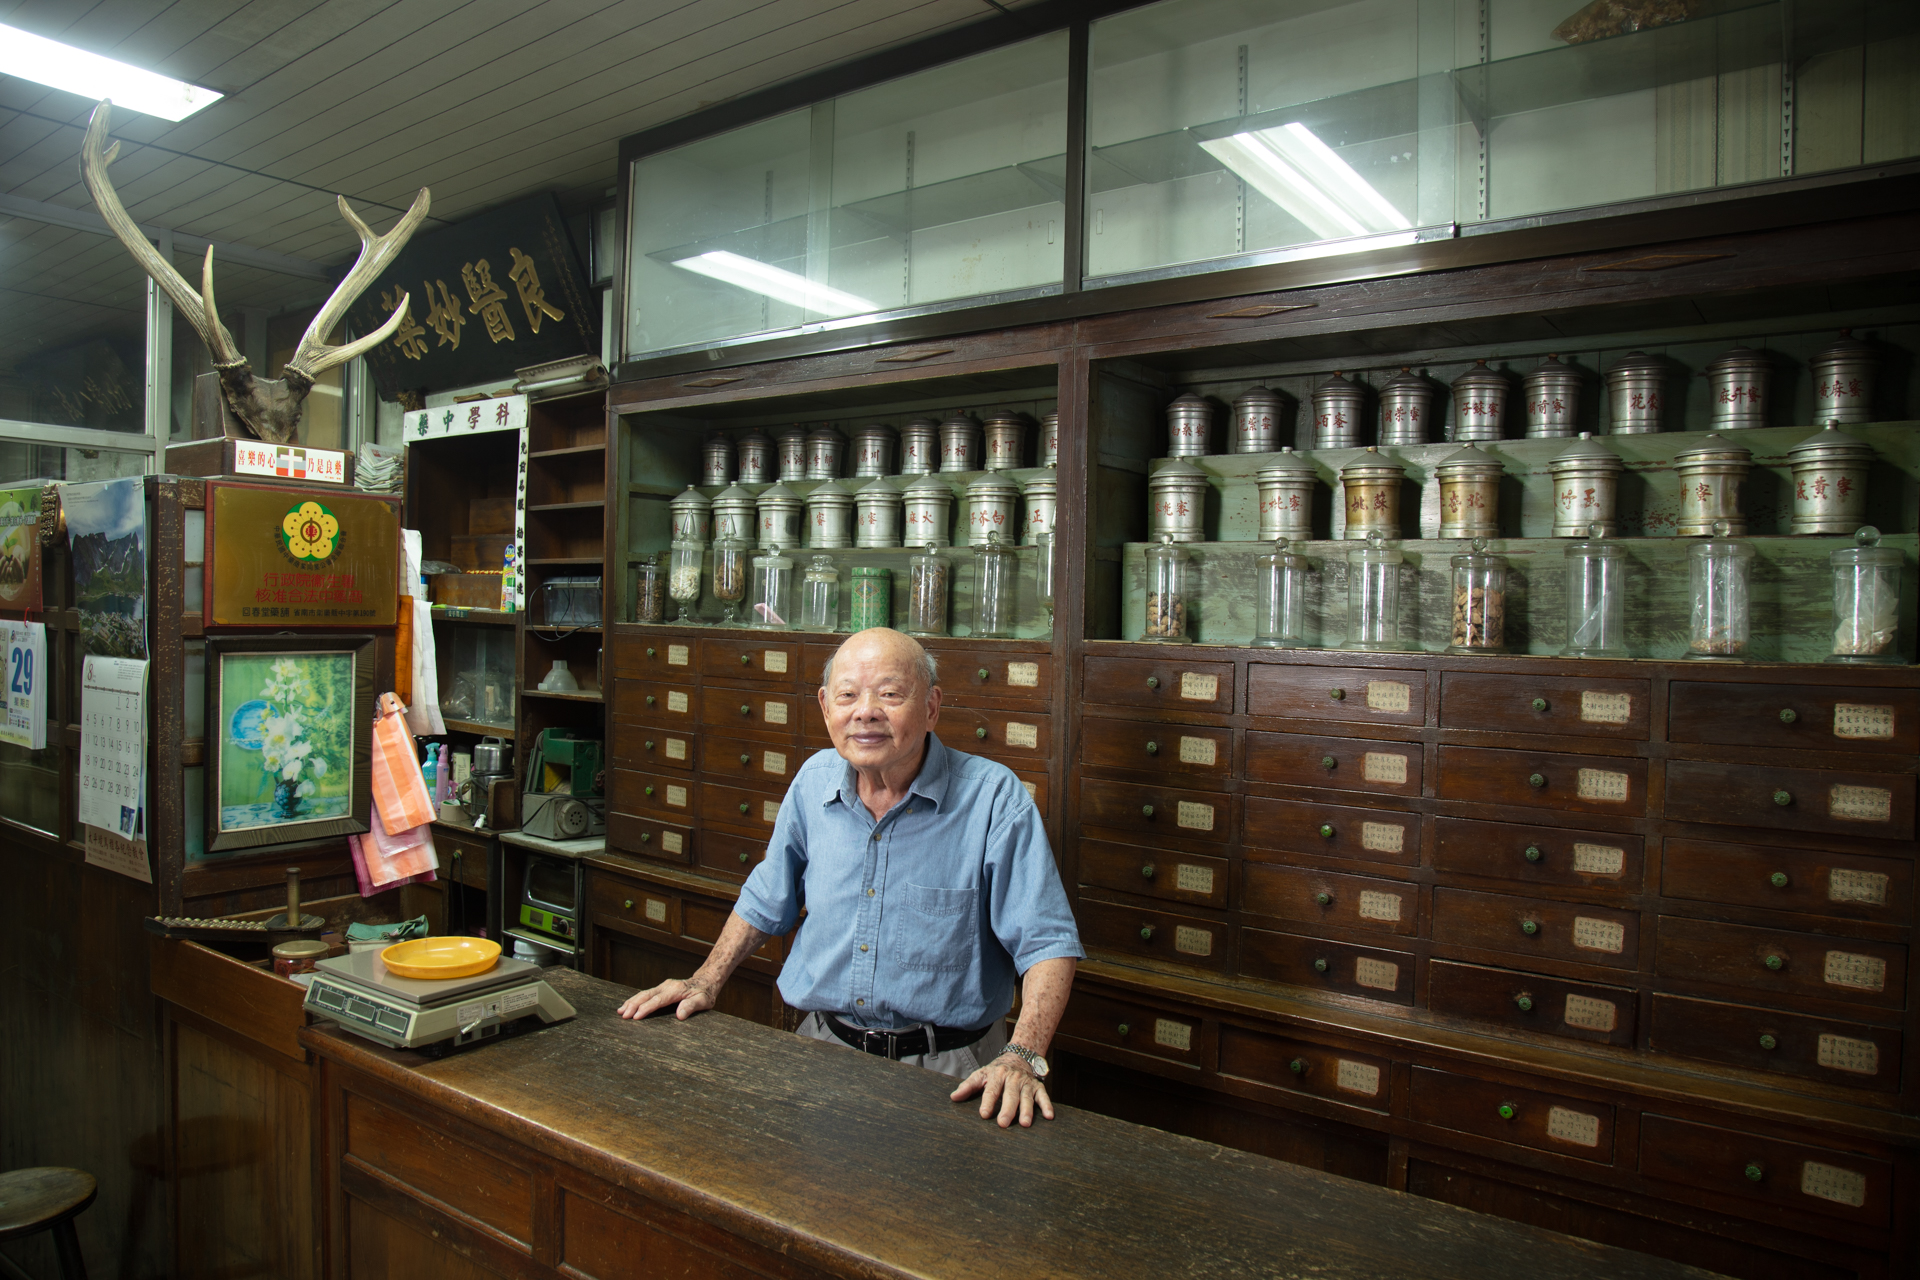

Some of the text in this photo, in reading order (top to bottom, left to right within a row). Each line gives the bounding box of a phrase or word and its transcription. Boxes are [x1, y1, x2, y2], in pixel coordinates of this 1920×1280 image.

[941, 443, 967, 457] 柏子
[237, 449, 342, 475] 喜樂的心 乃是良藥
[255, 588, 363, 604] 核准合法中藥商
[11, 646, 34, 696] 29
[87, 663, 94, 681] 8
[134, 720, 140, 733] 10
[85, 733, 140, 755] 11 12 13 14 15 16 17
[84, 754, 139, 778] 18 19 20 21 22 23 24
[84, 775, 138, 800] 25 26 27 28 29 30 31
